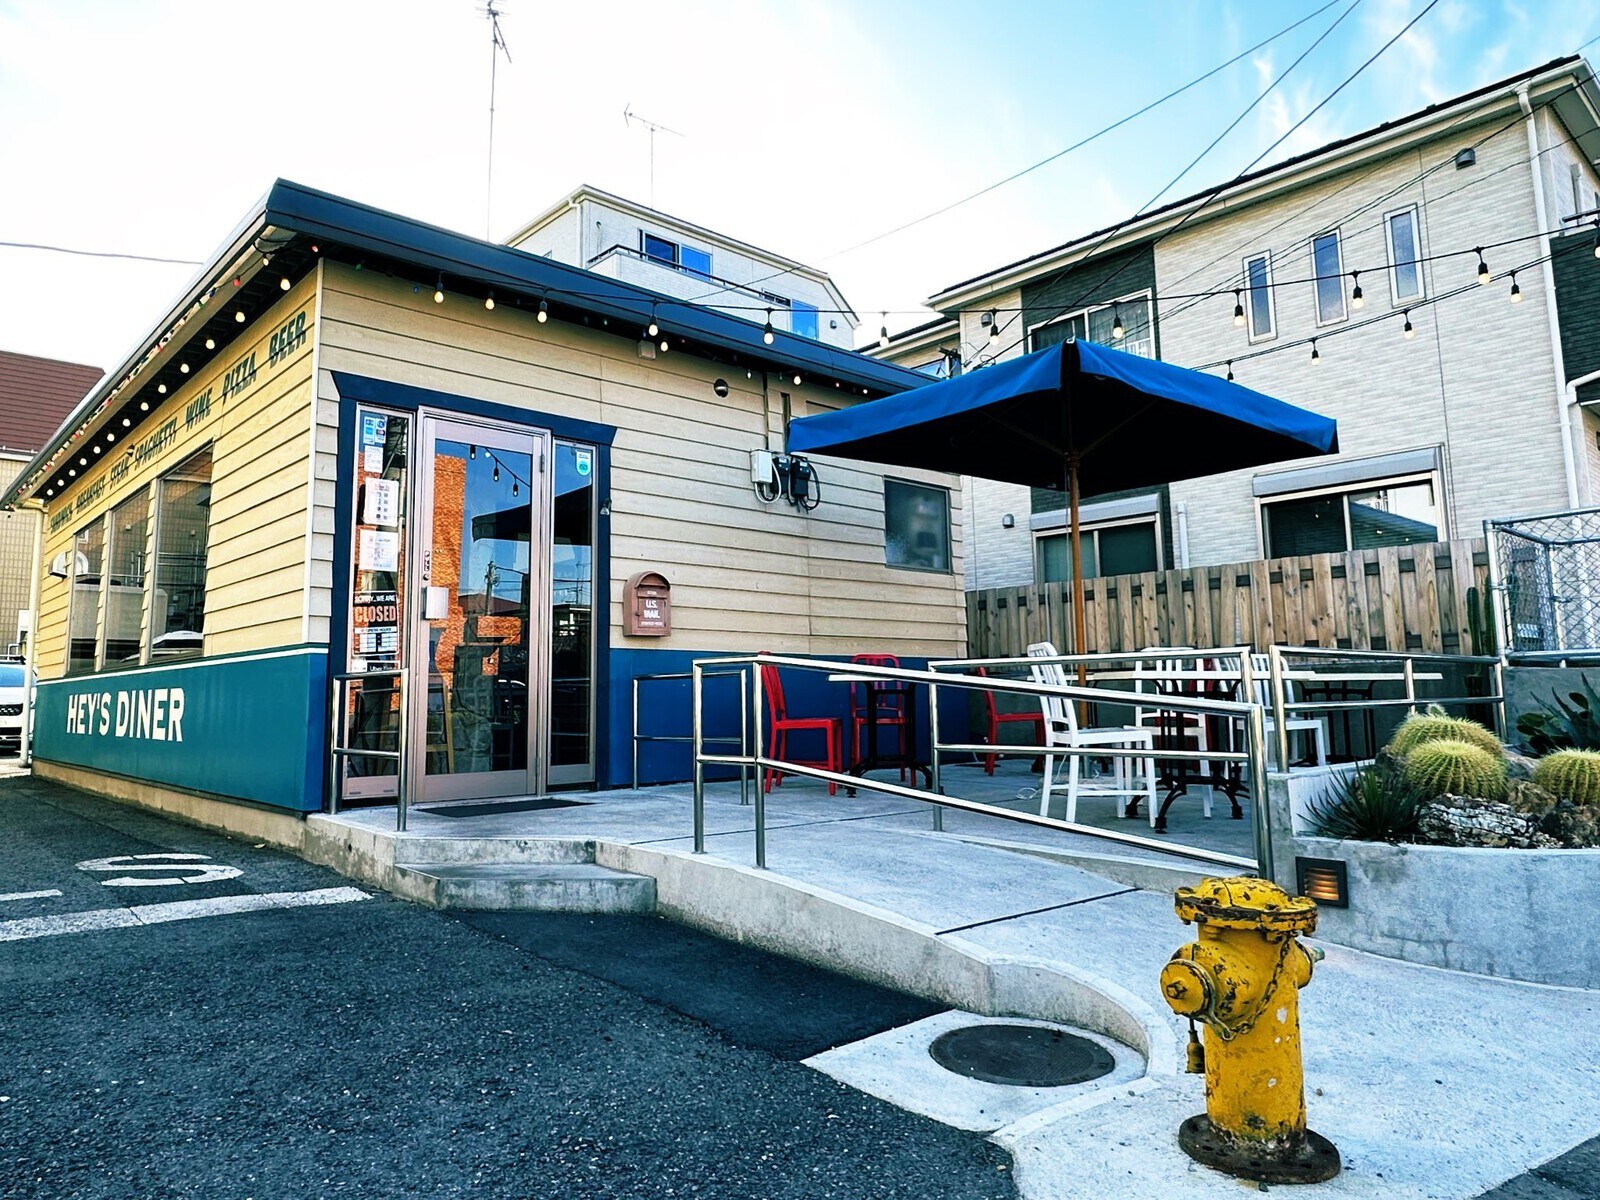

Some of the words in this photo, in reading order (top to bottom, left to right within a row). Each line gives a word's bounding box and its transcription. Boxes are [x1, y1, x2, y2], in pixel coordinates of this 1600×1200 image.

[134, 417, 177, 471] SPAGHETTI
[185, 387, 212, 432] WINE
[222, 351, 257, 406] PIZZA
[268, 311, 306, 369] BEER
[354, 605, 397, 623] CLOSED
[643, 609, 661, 618] MAIL
[66, 692, 112, 736] HEY'S
[115, 687, 185, 742] DINER
